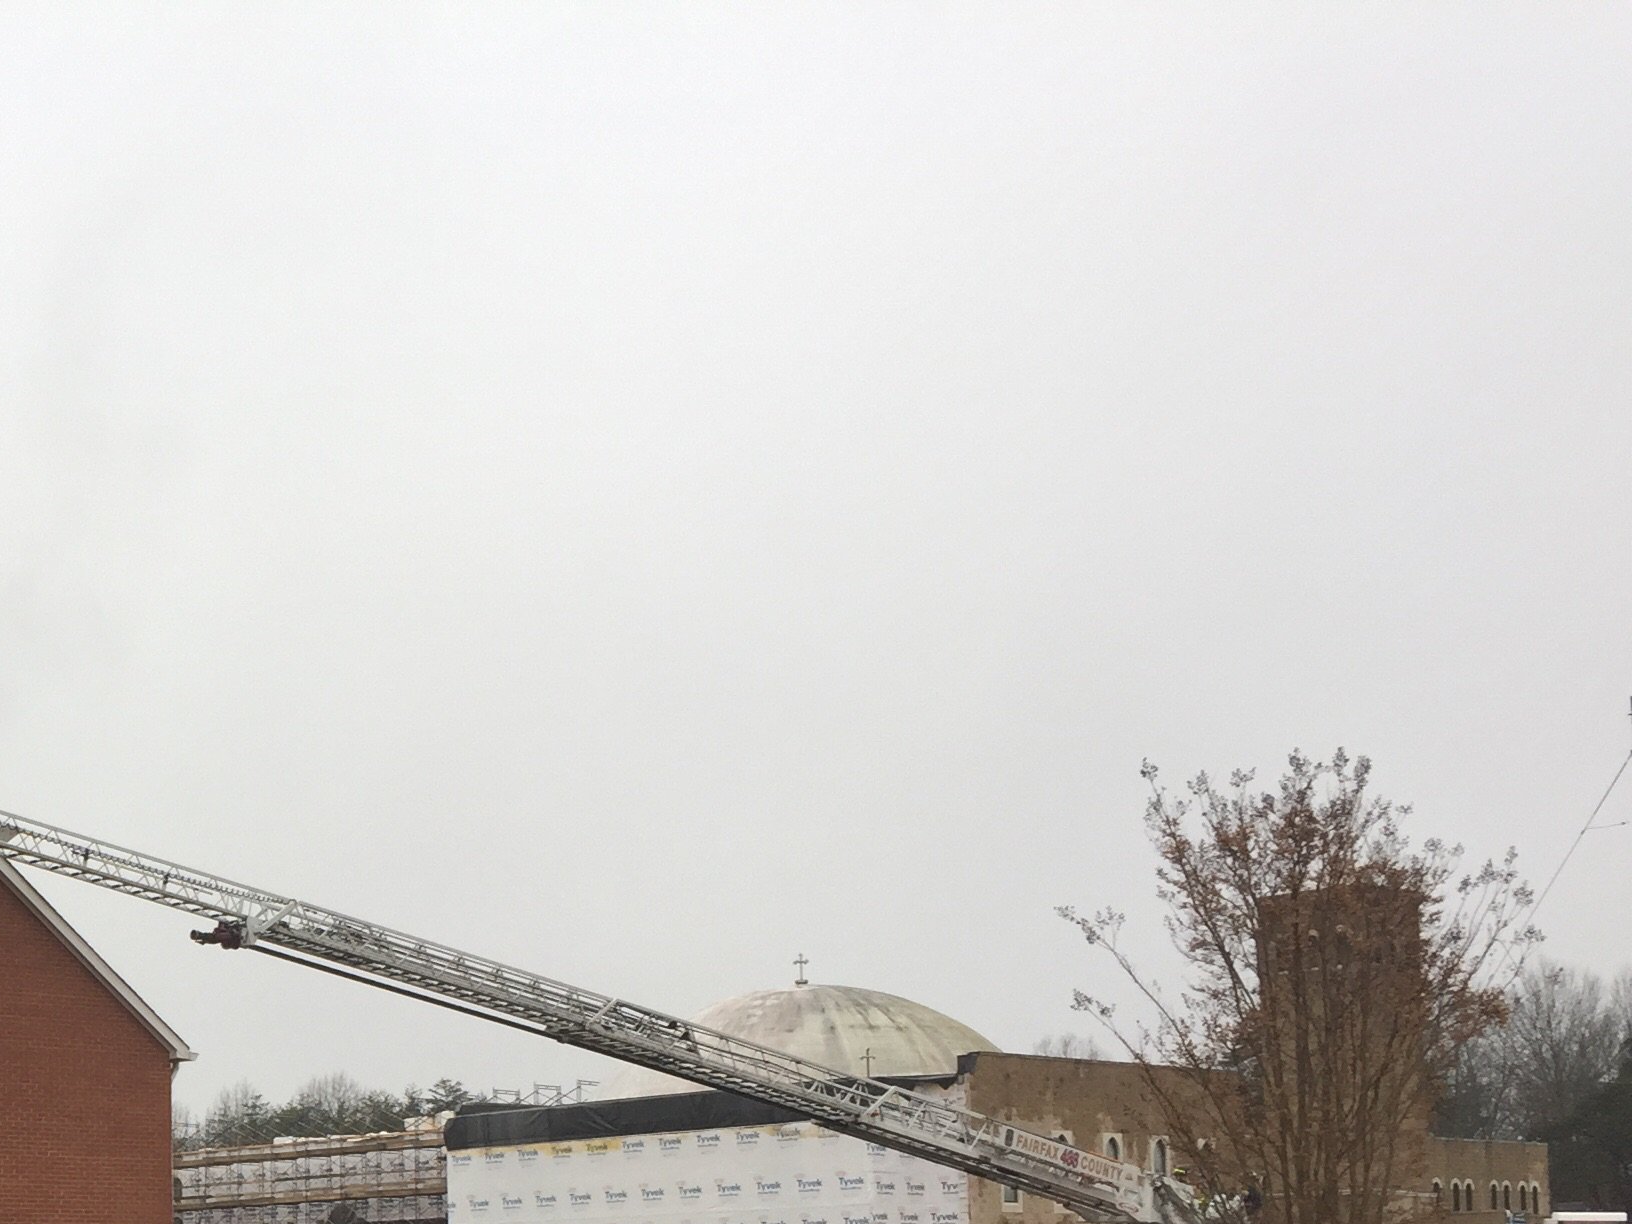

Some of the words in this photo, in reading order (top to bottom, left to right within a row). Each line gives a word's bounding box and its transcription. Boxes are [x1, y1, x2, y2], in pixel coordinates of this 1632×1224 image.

[1017, 1134, 1059, 1159] FAIRFAX
[1081, 1156, 1124, 1180] COUNTY
[942, 1182, 958, 1191] Tyv
